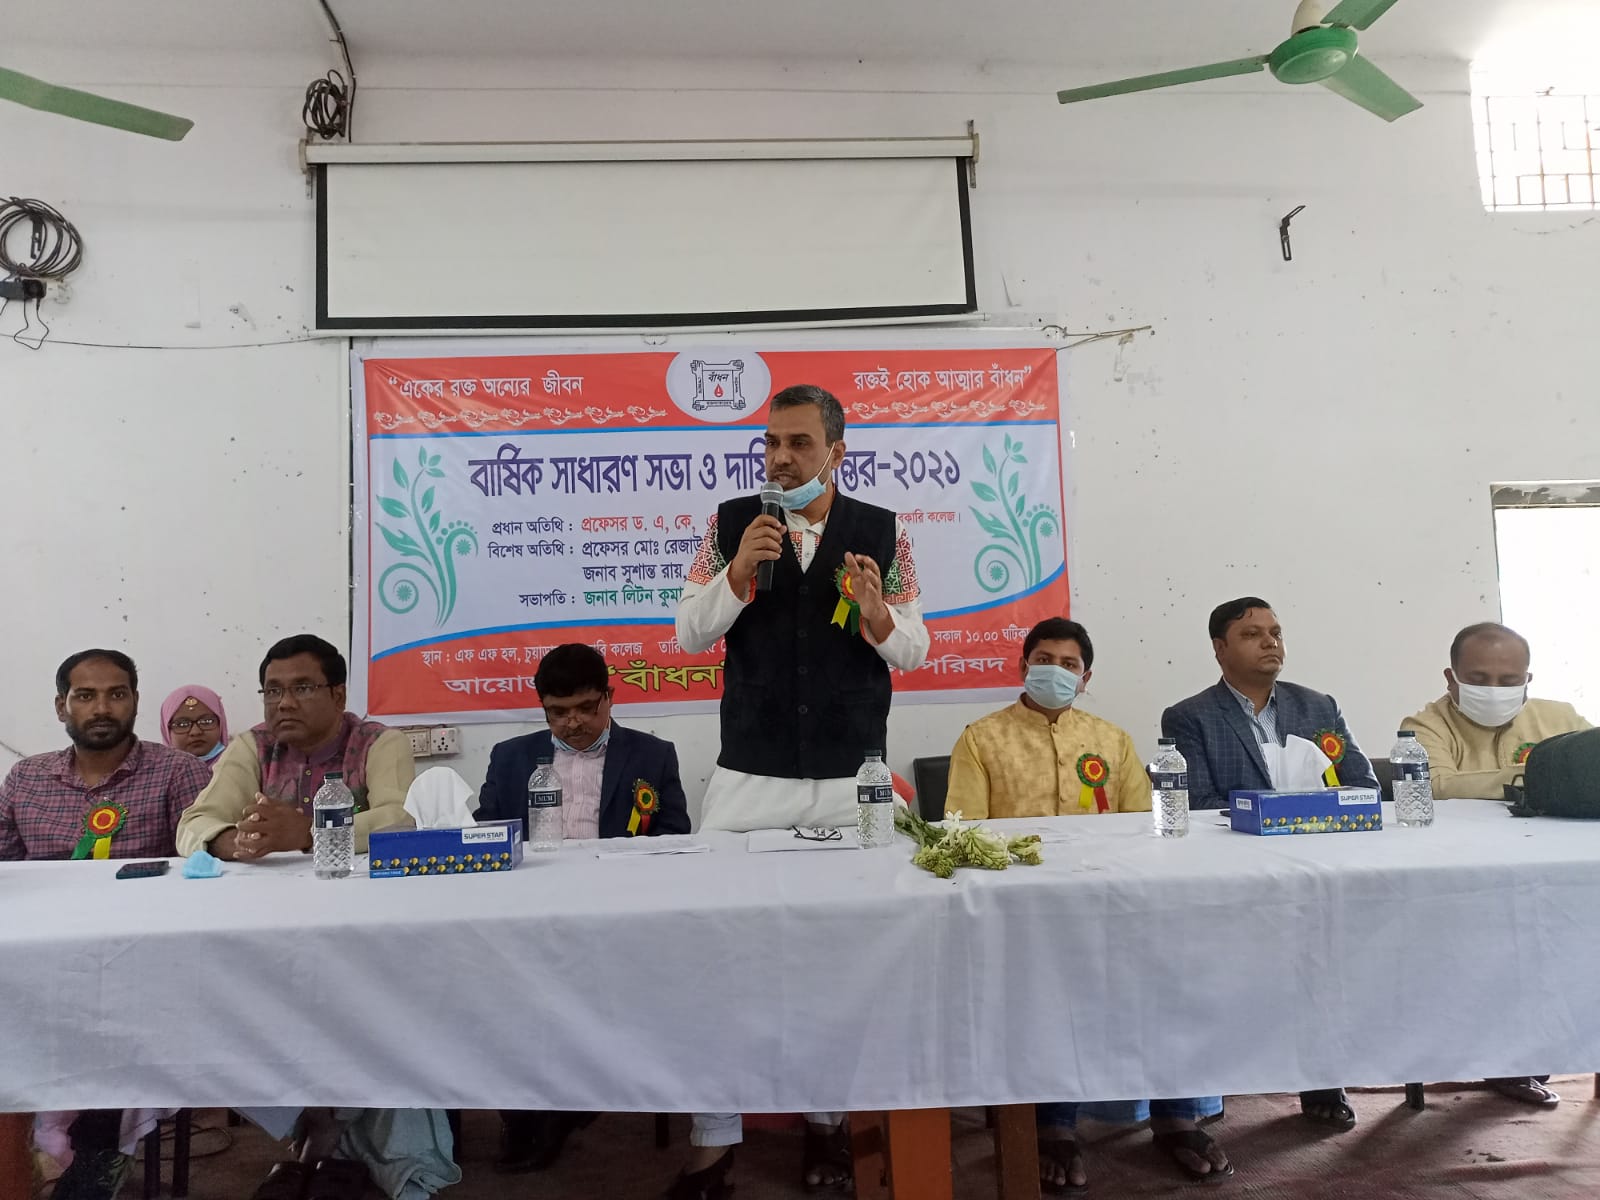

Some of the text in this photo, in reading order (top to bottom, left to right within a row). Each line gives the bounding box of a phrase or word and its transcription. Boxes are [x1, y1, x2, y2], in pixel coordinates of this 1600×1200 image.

[449, 377, 478, 398] রক্ত
[480, 376, 532, 398] অন্যের
[540, 369, 585, 397] জীবন
[853, 366, 891, 393] রক্তই
[896, 368, 931, 393] হোক
[934, 368, 985, 393] আত্মার
[468, 442, 544, 497] বার্ষিক
[550, 455, 638, 495] সাধারণ
[644, 453, 692, 492] সভা
[698, 453, 718, 491] ও
[491, 519, 522, 536] প্রধান
[526, 516, 564, 533] অতিথি
[580, 515, 628, 533] প্রফেসর
[487, 541, 523, 559] বিশেষ
[526, 538, 565, 557] অতিথি
[582, 541, 630, 558] প্রফেসর
[634, 538, 660, 556] মোঃ
[582, 564, 617, 583] জনাব
[621, 563, 657, 585] সুশান্ত
[519, 588, 567, 608] সভাপতি
[583, 588, 617, 606] জনাব
[621, 584, 653, 605] লিটন
[933, 629, 962, 644] সকাল
[421, 650, 443, 668] স্থান
[454, 648, 475, 664] এফ
[478, 648, 498, 663] এফ
[609, 642, 644, 657] কলেজ
[463, 832, 486, 840] SUPER
[487, 831, 504, 840] STAR
